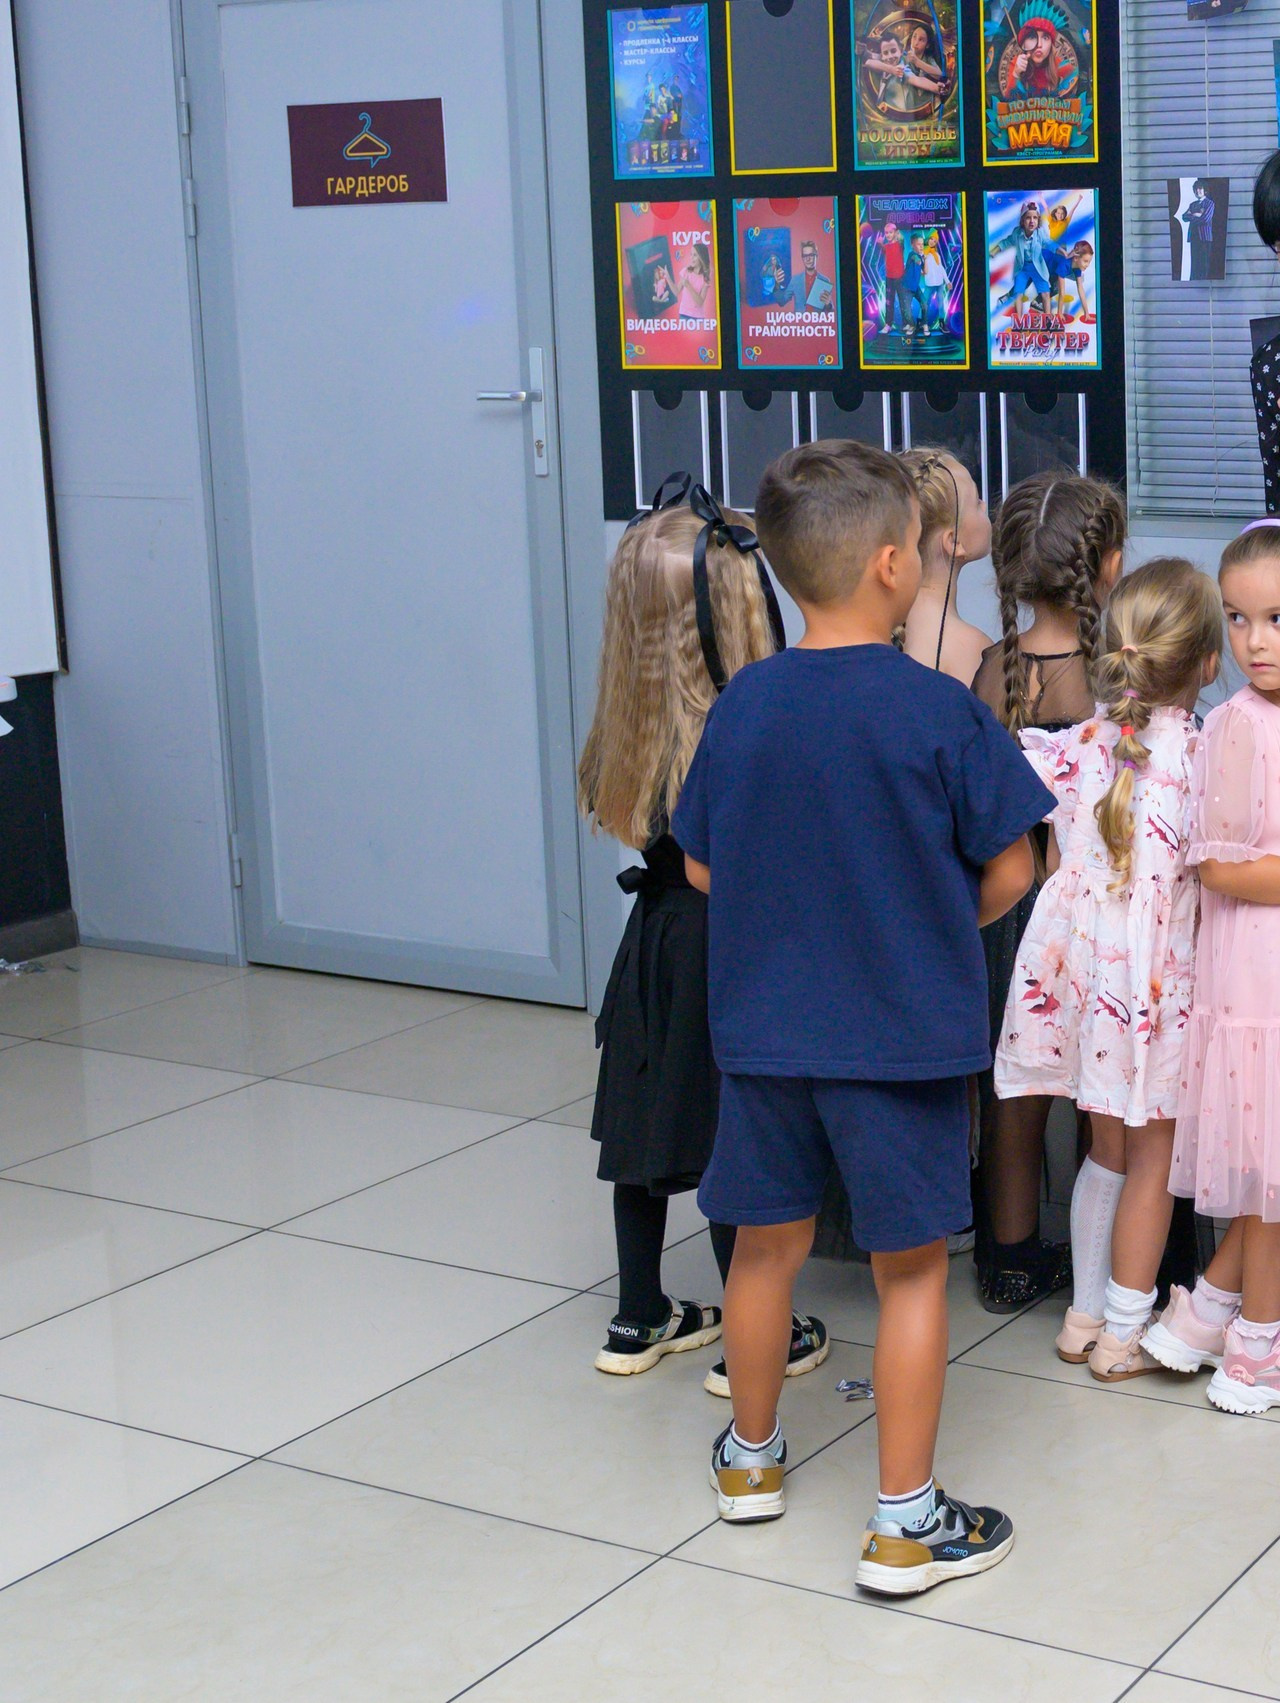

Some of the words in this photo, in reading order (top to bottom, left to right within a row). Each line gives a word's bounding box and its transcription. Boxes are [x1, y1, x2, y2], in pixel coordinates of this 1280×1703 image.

[672, 35, 699, 43] КЛАССЫ
[623, 47, 676, 56] МАСТЕР-КЛАССЫ
[860, 125, 957, 143] ГОЛОДНЫЕ
[1008, 119, 1073, 149] МАЙЯ
[884, 144, 931, 157] ИГРЫ
[326, 174, 409, 198] ГАРДЕРОБ
[872, 198, 949, 211] ЧЕЛЛЕНДЖ
[886, 211, 936, 224] АРЕНА
[672, 230, 711, 246] КУРС
[626, 318, 717, 334] ВИДЕОБЛОГЕР
[766, 311, 835, 326] ЦИФРОВАЯ
[1011, 313, 1065, 330] МЕГА
[748, 325, 836, 337] ГРАМОТНОСТЬ
[997, 331, 1090, 350] ТВИСТЕР
[609, 1323, 639, 1337] SHION
